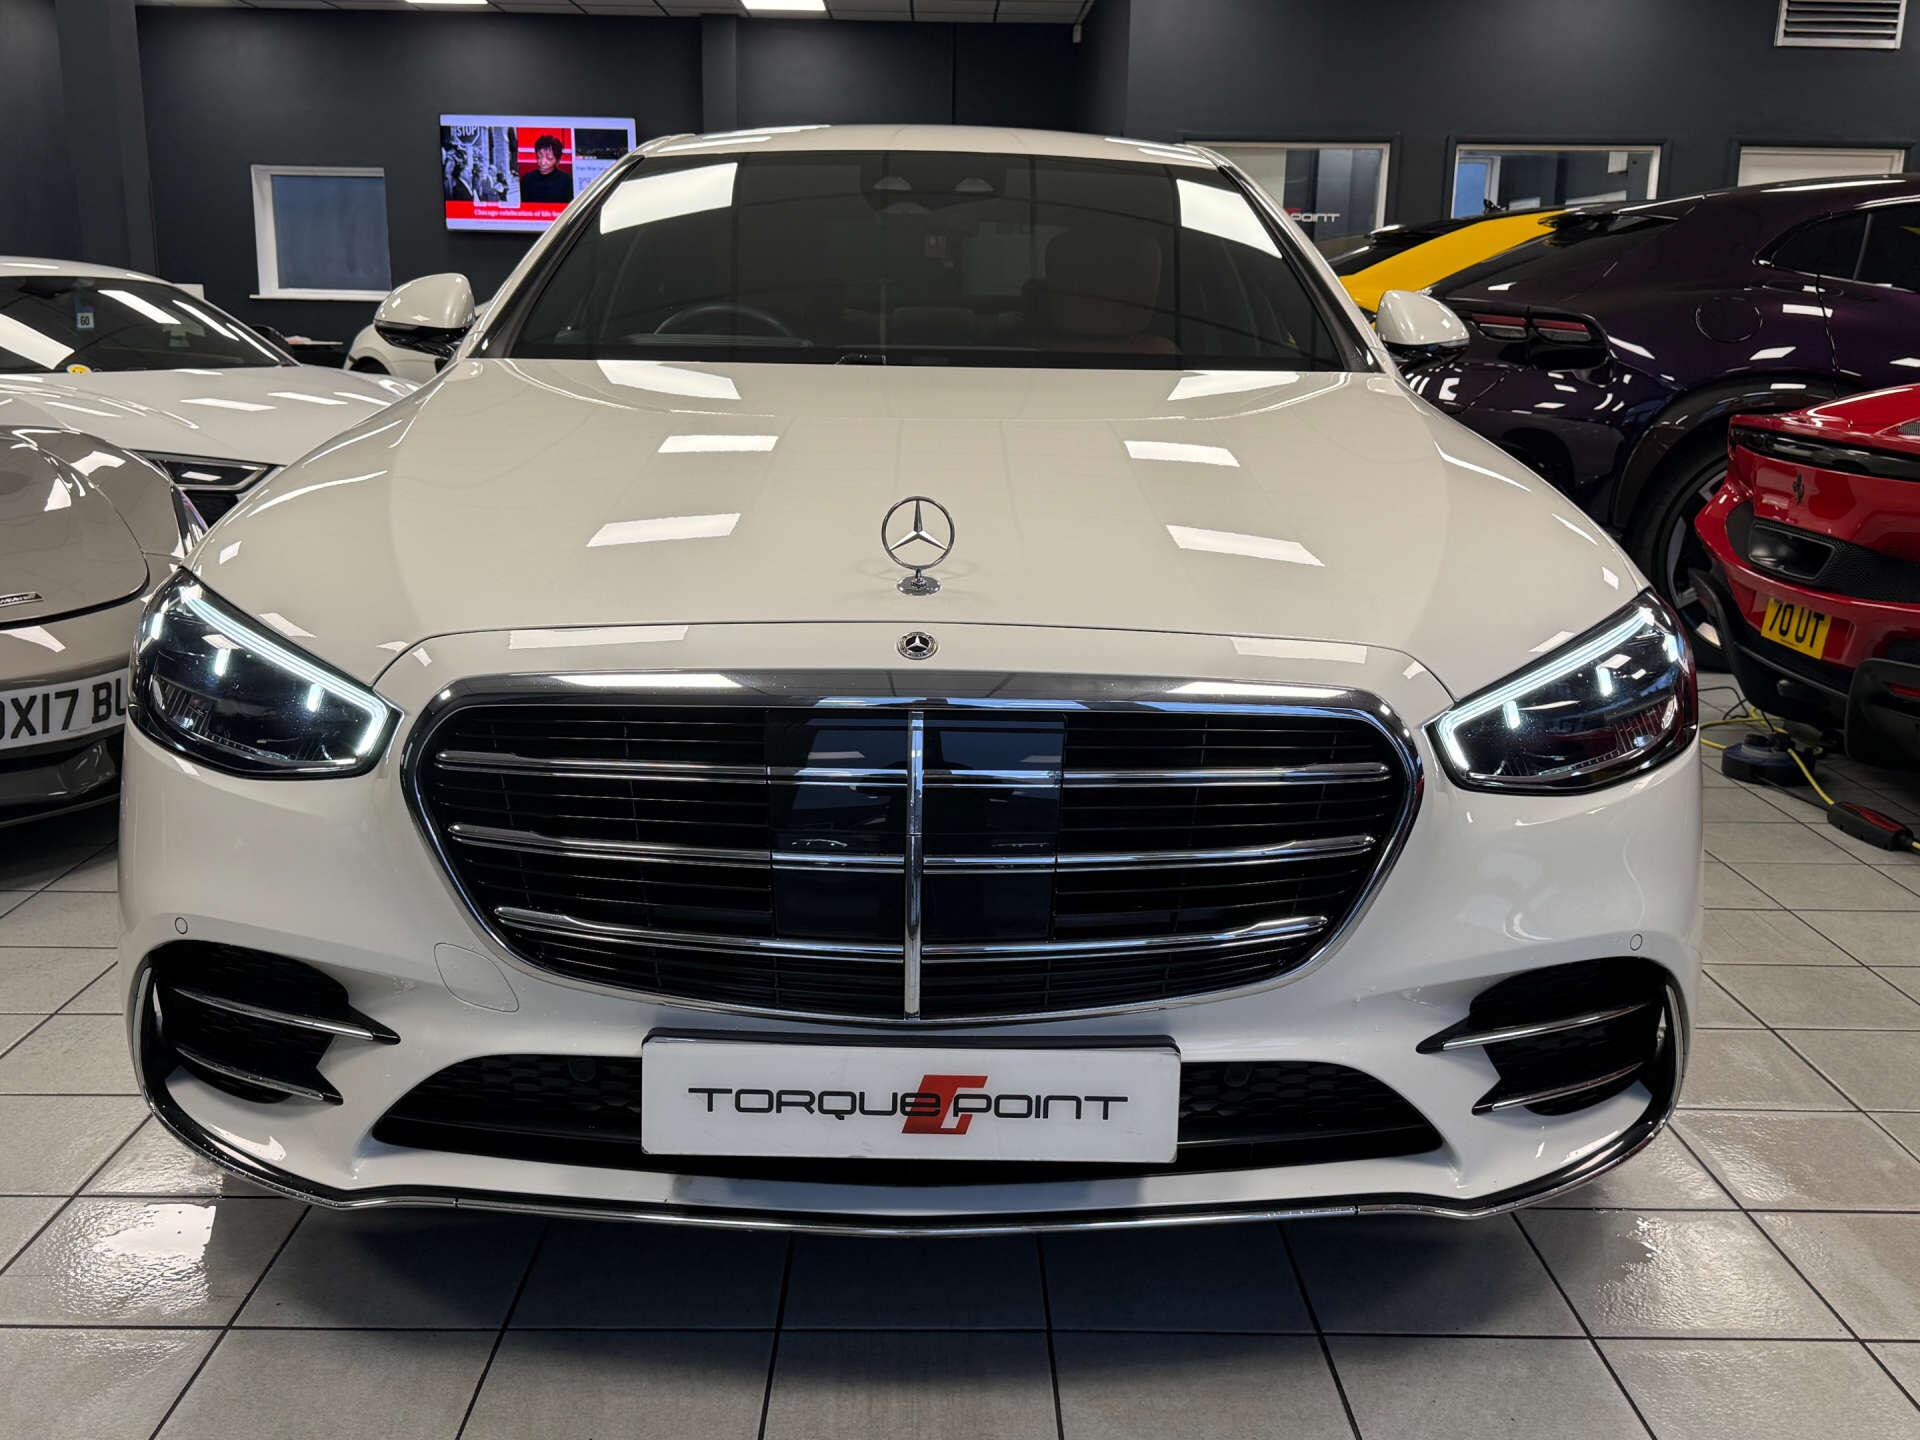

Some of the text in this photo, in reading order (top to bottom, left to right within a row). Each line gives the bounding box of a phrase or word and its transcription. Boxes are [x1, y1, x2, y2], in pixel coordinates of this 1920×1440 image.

[1290, 212, 1340, 223] POINT
[1795, 607, 1825, 648] UT
[0, 688, 79, 740] X17
[688, 1087, 1128, 1120] TORQUE POINT
